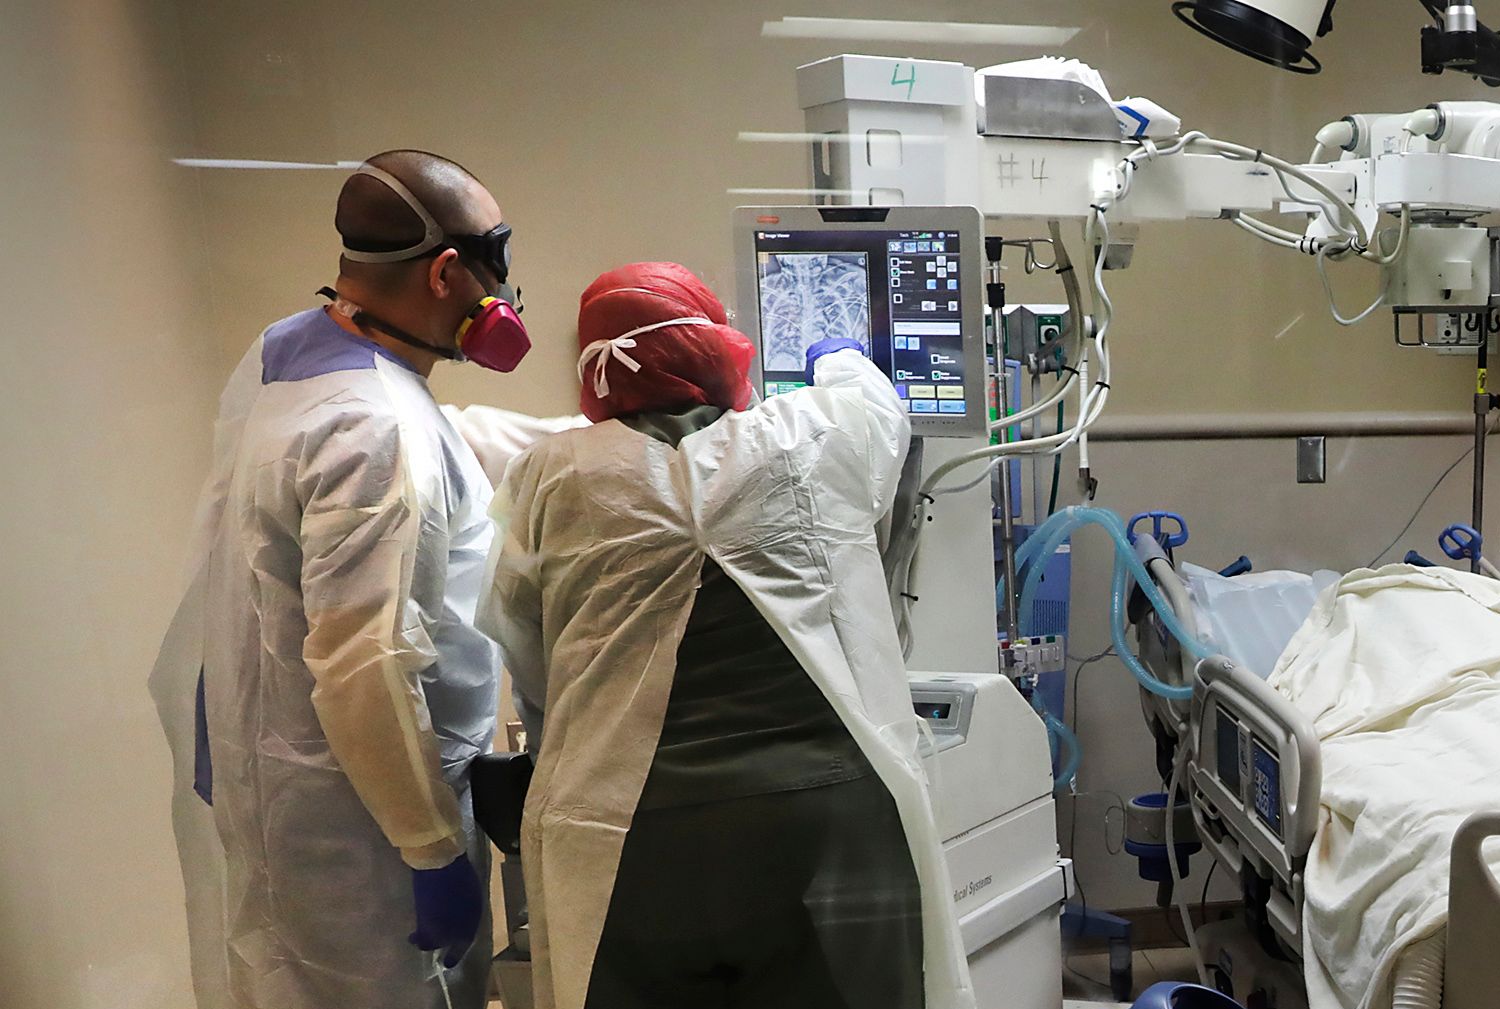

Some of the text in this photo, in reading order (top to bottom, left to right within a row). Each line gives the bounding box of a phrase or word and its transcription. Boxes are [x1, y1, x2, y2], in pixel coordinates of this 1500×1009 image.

[891, 63, 916, 100] 4
[953, 874, 992, 903] dical Systems
